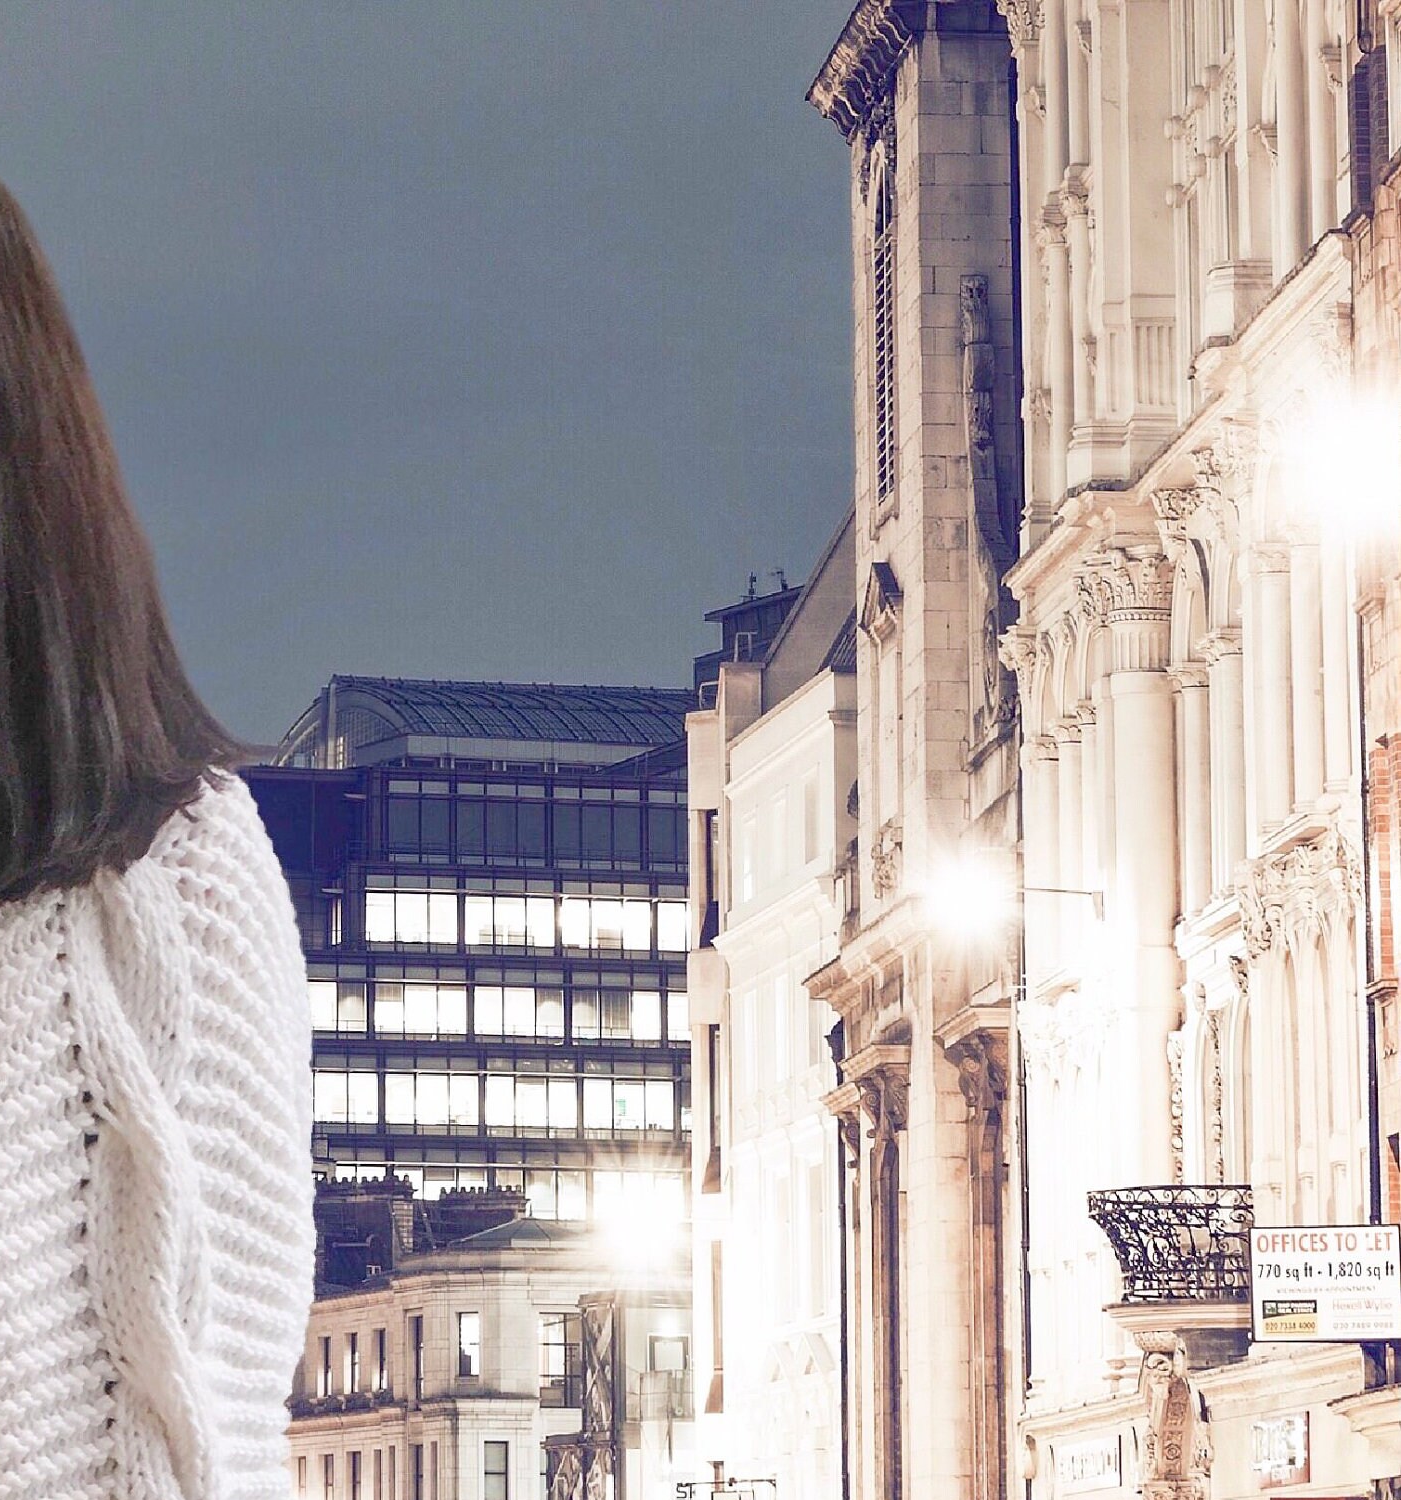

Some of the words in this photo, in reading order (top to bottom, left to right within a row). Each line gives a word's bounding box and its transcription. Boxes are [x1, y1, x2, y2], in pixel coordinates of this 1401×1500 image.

[1257, 1233, 1329, 1253] OFFICES
[1334, 1233, 1357, 1252] TO
[1365, 1232, 1394, 1251] LET
[1258, 1264, 1281, 1278] 770
[1285, 1267, 1300, 1282] sq
[1304, 1262, 1313, 1277] ft
[1328, 1262, 1362, 1281] 1,820
[1367, 1266, 1381, 1281] sq
[1386, 1261, 1395, 1276] ft
